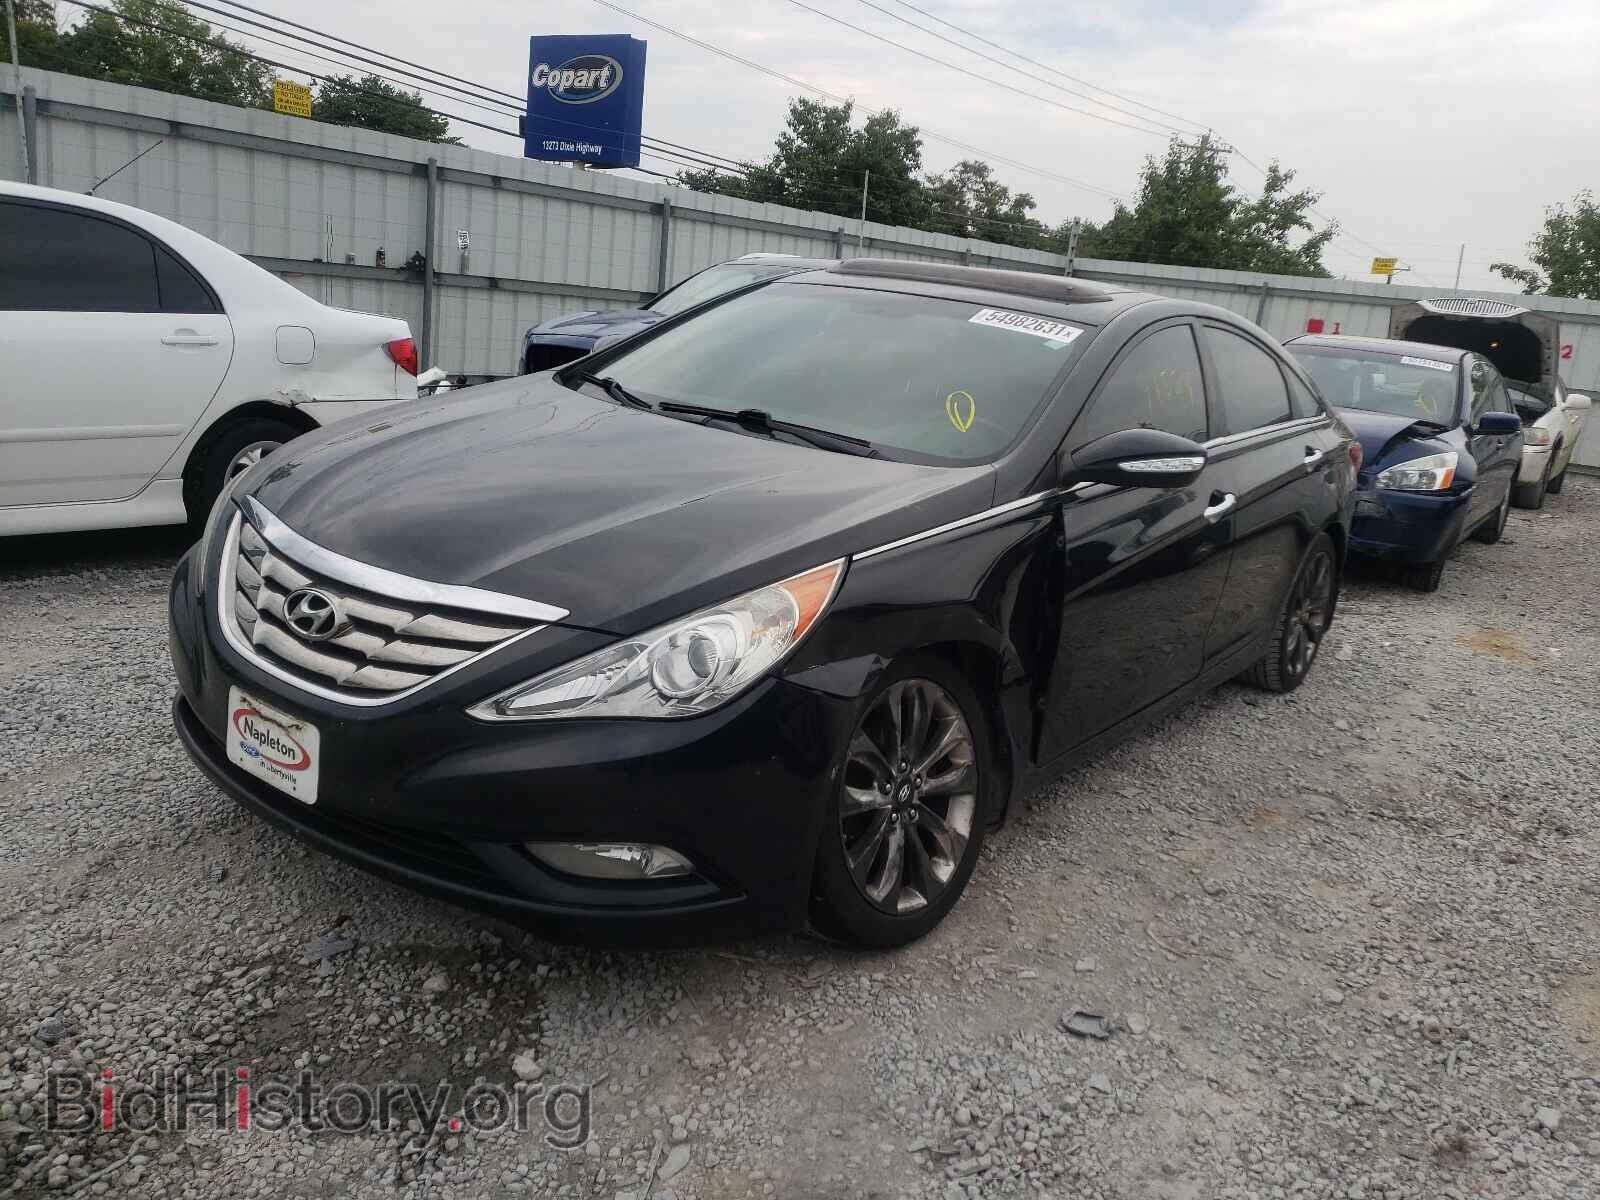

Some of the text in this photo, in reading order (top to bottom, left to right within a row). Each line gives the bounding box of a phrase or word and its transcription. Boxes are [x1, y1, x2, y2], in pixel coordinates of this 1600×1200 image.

[532, 62, 612, 93] Copart
[576, 142, 602, 156] Highway
[985, 311, 1063, 335] 54982631
[1331, 321, 1341, 335] 1
[1560, 345, 1573, 359] 2
[243, 717, 296, 760] Napleton
